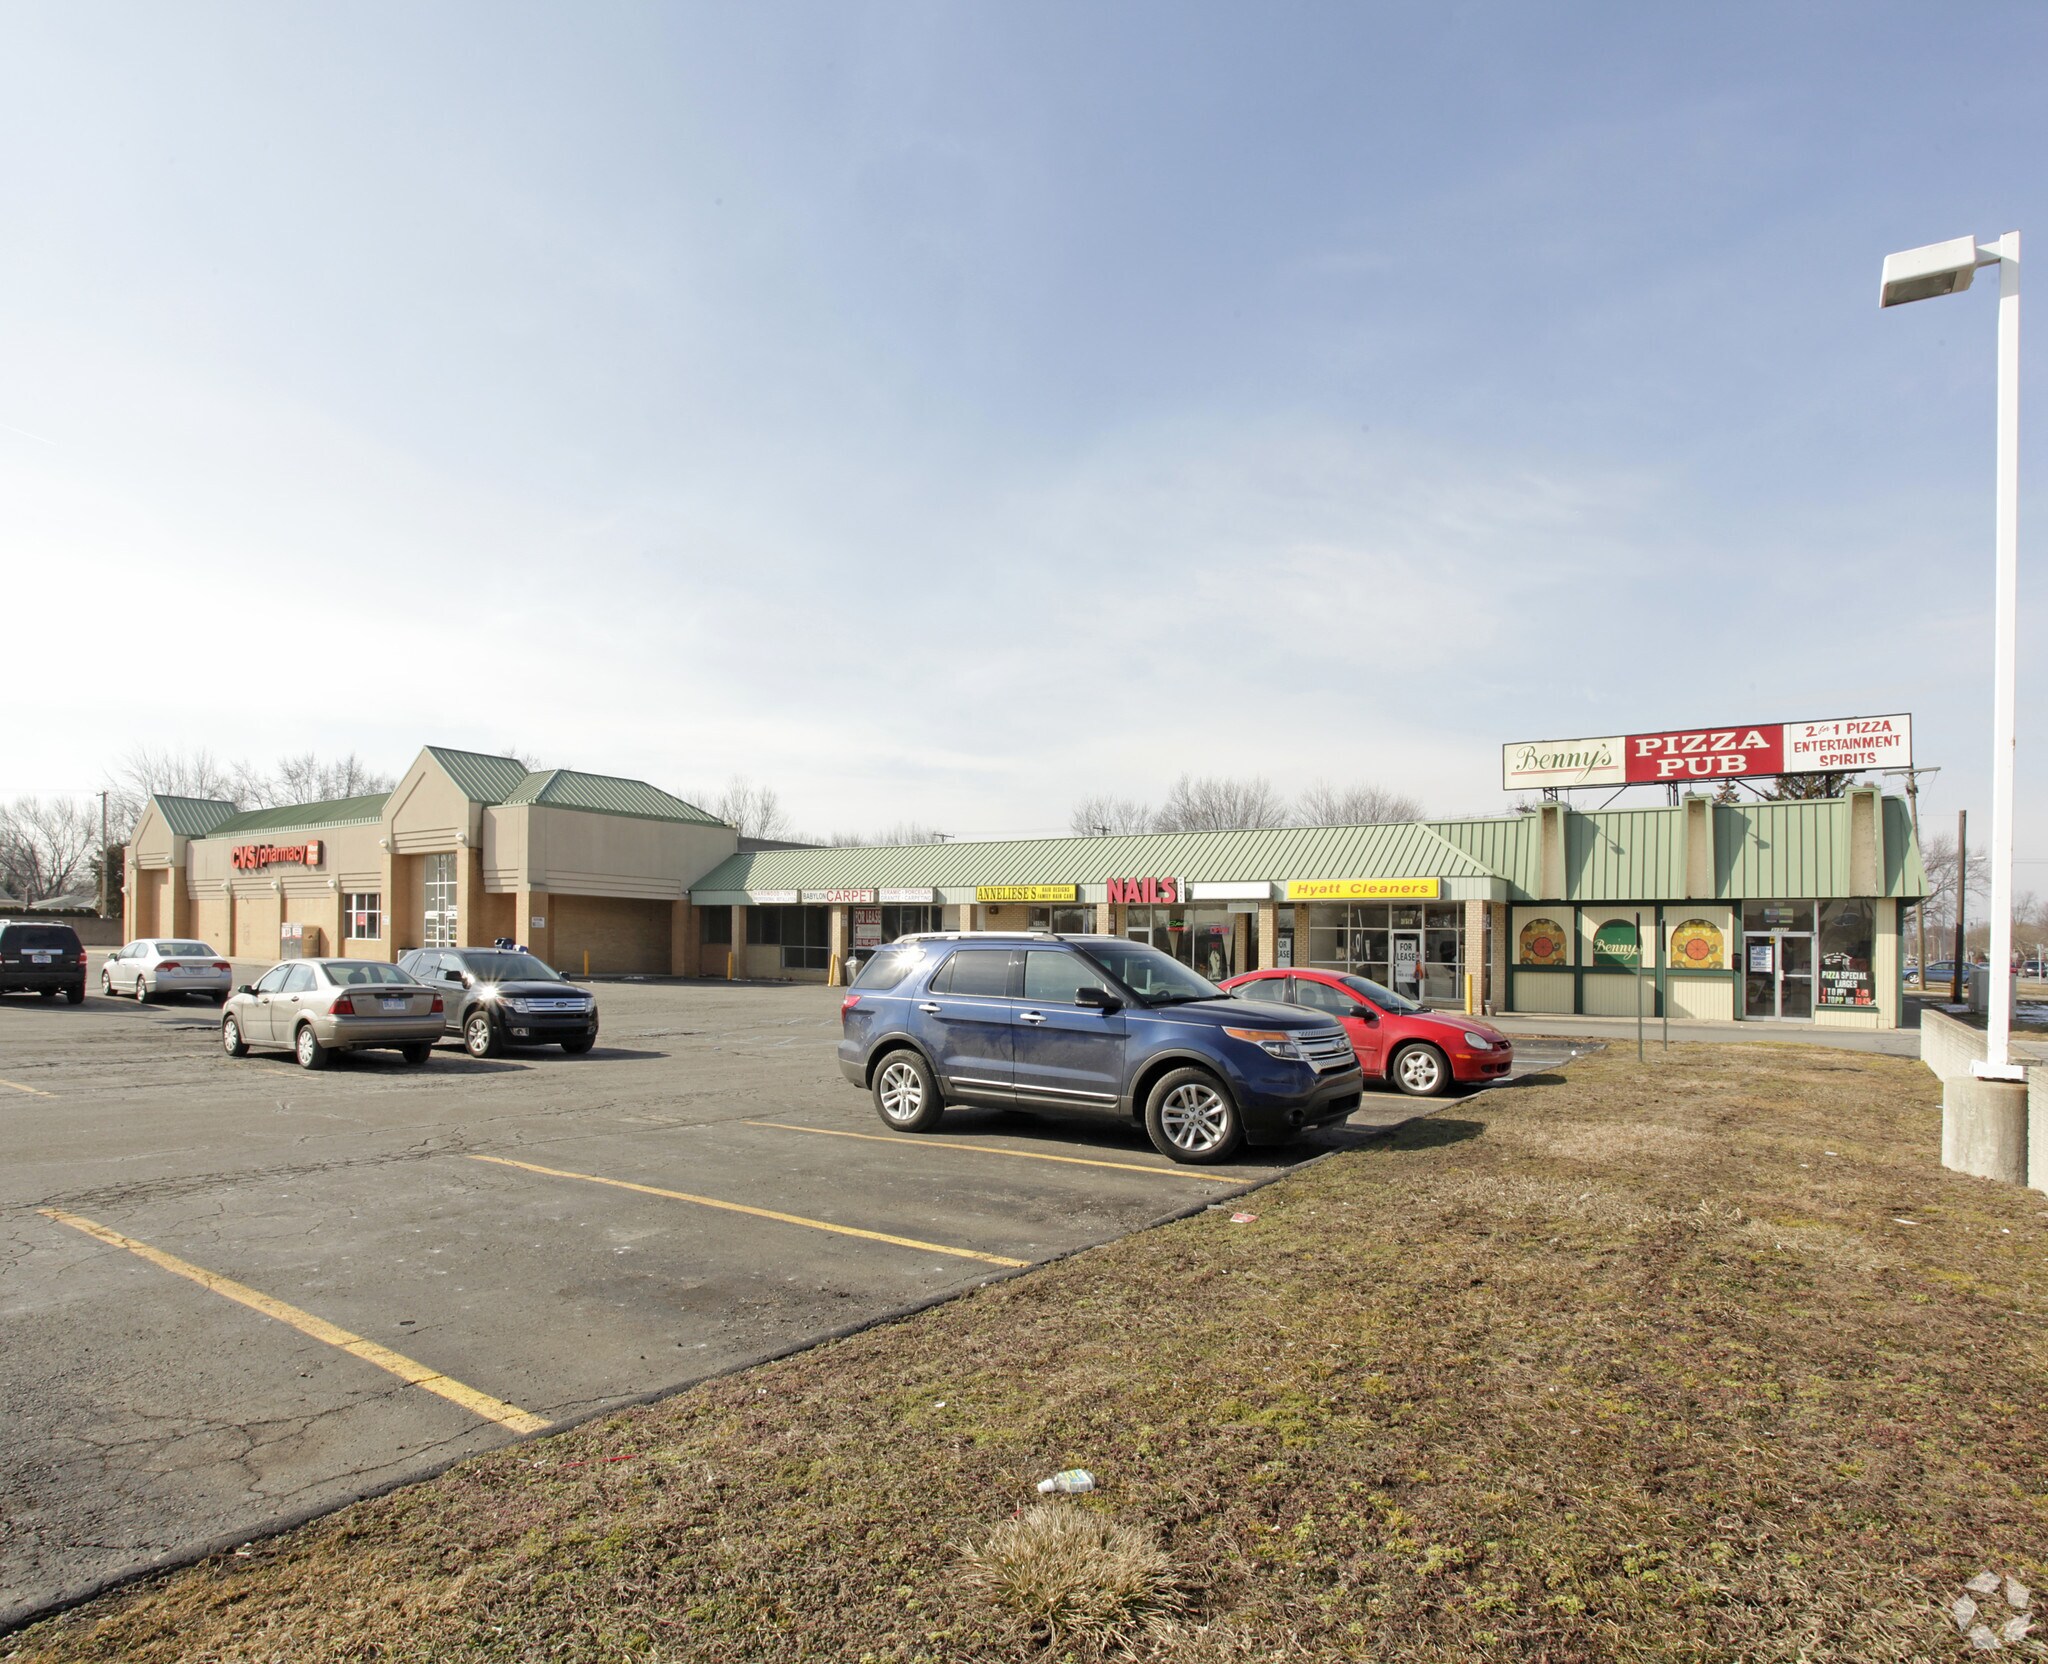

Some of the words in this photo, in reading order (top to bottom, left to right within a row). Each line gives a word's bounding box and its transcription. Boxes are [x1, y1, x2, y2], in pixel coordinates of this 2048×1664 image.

[1805, 725, 1818, 737] 2
[1818, 724, 1830, 735] for
[1832, 724, 1840, 735] 1
[1846, 719, 1893, 735] PIZZA
[1635, 730, 1771, 758] PIZZA
[1793, 734, 1902, 753] ENTERTAINMENT
[1516, 742, 1613, 784] Benny's
[1656, 754, 1748, 778] PUB
[1819, 752, 1877, 767] SPIRITS
[230, 845, 305, 869] CVS/pharmacy
[802, 892, 826, 900] BABYLON
[826, 890, 874, 902] CARPET
[977, 886, 1038, 900] ANNELIESE'S
[1106, 876, 1177, 904] NAILS
[1297, 883, 1341, 896] Hyatt
[1350, 883, 1429, 894] Cleaners
[1278, 940, 1287, 948] OR
[1399, 942, 1413, 951] FOR
[1594, 938, 1643, 960] Benny
[1278, 950, 1290, 958] ASE
[1396, 952, 1416, 961] LEASE
[1821, 970, 1840, 979] PIZZA
[1840, 971, 1867, 980] SPECIAL
[1834, 979, 1858, 988] LARGES
